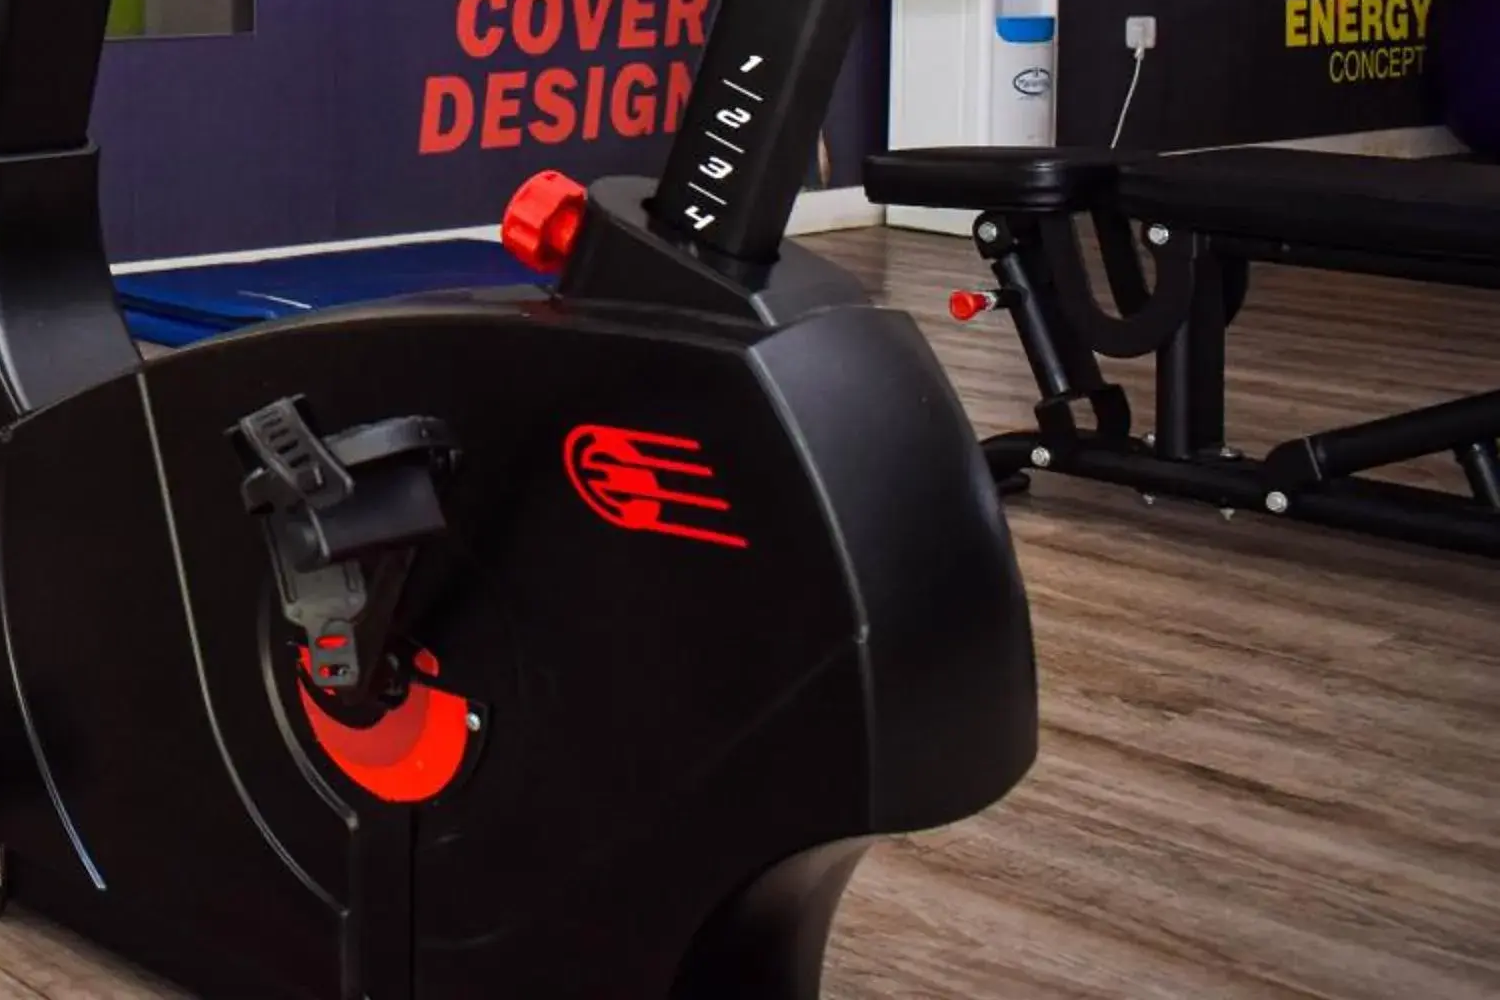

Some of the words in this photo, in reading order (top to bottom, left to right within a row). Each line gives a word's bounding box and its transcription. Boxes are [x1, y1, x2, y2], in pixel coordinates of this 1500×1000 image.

[740, 56, 763, 73] 1
[1329, 45, 1426, 83] CONCEPT
[716, 107, 751, 129] 2
[699, 156, 733, 179] 3
[684, 205, 715, 230] 4
